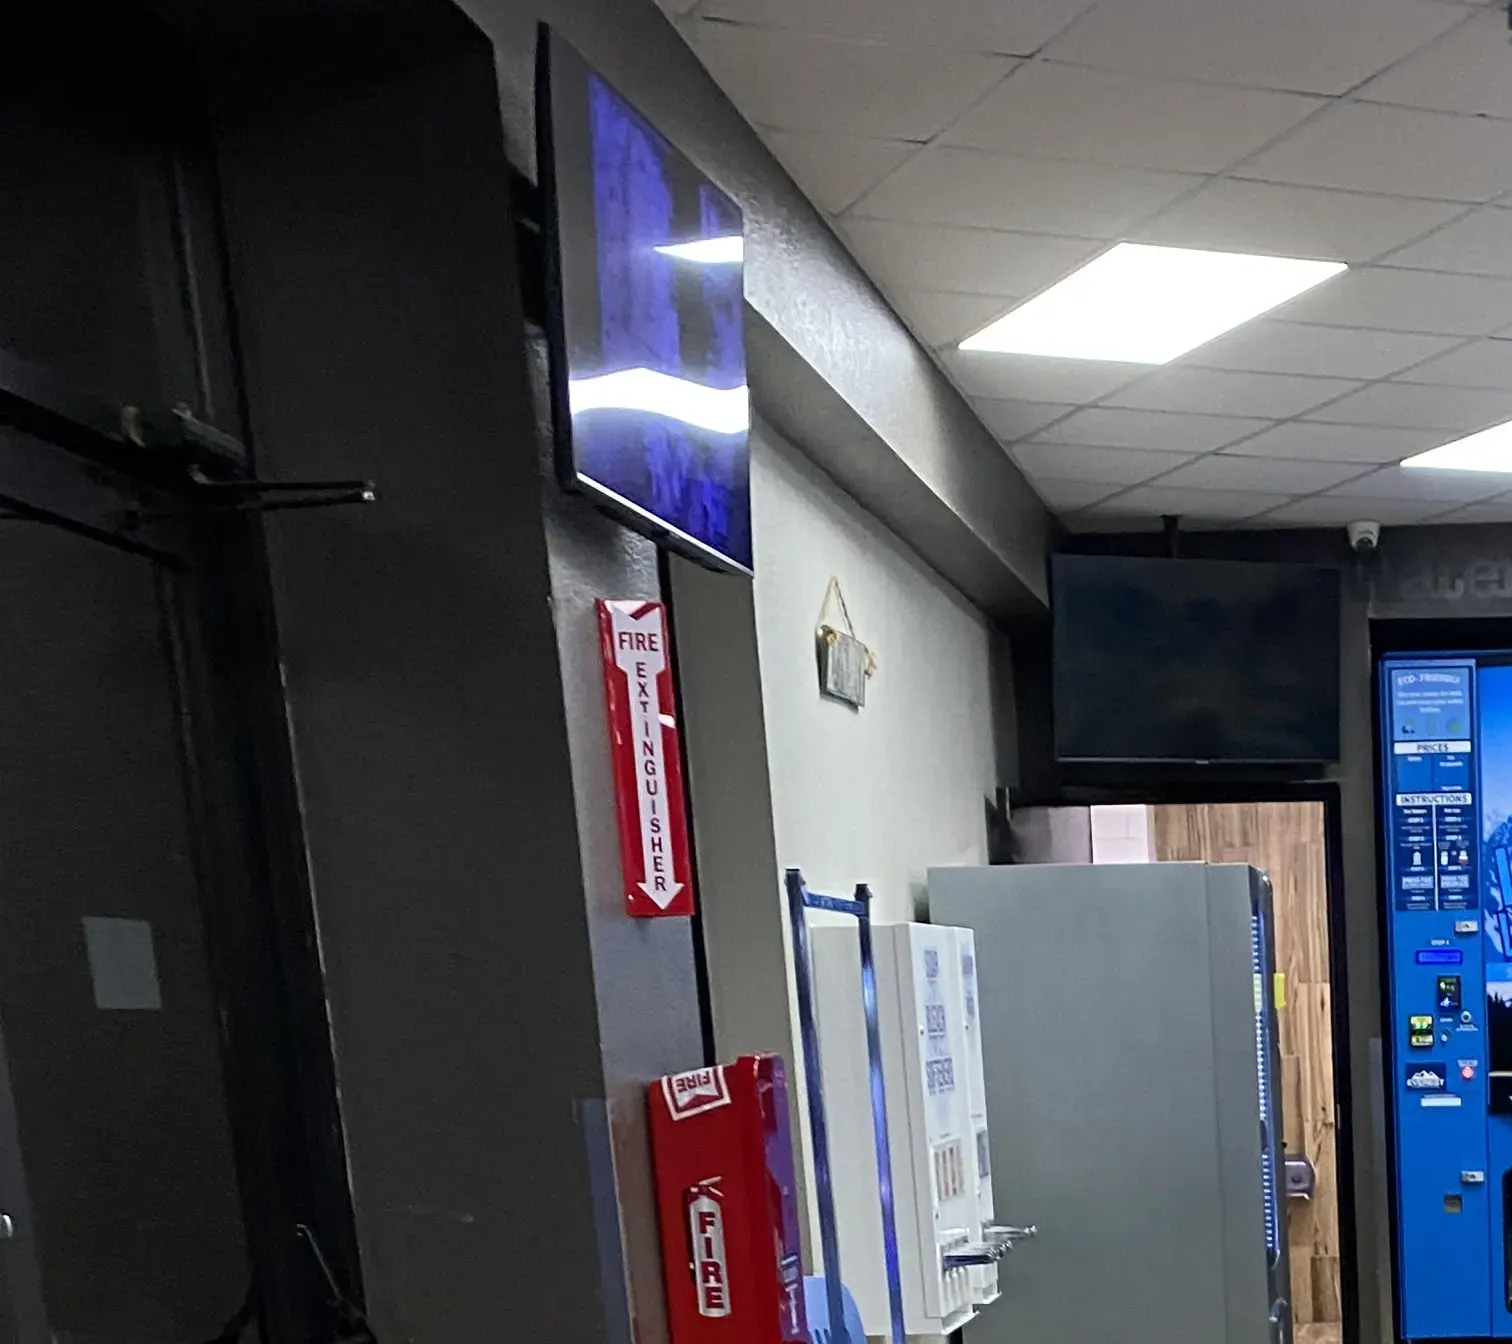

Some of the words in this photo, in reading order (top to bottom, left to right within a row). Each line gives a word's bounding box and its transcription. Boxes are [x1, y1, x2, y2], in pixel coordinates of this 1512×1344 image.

[618, 632, 659, 652] FIRE
[1416, 743, 1449, 752] PRICES
[635, 661, 667, 891] EXTINGUISHER
[1400, 794, 1468, 804] INSTRUCTIONS
[676, 1071, 711, 1093] FIRE
[700, 1212, 724, 1308] FIRE
